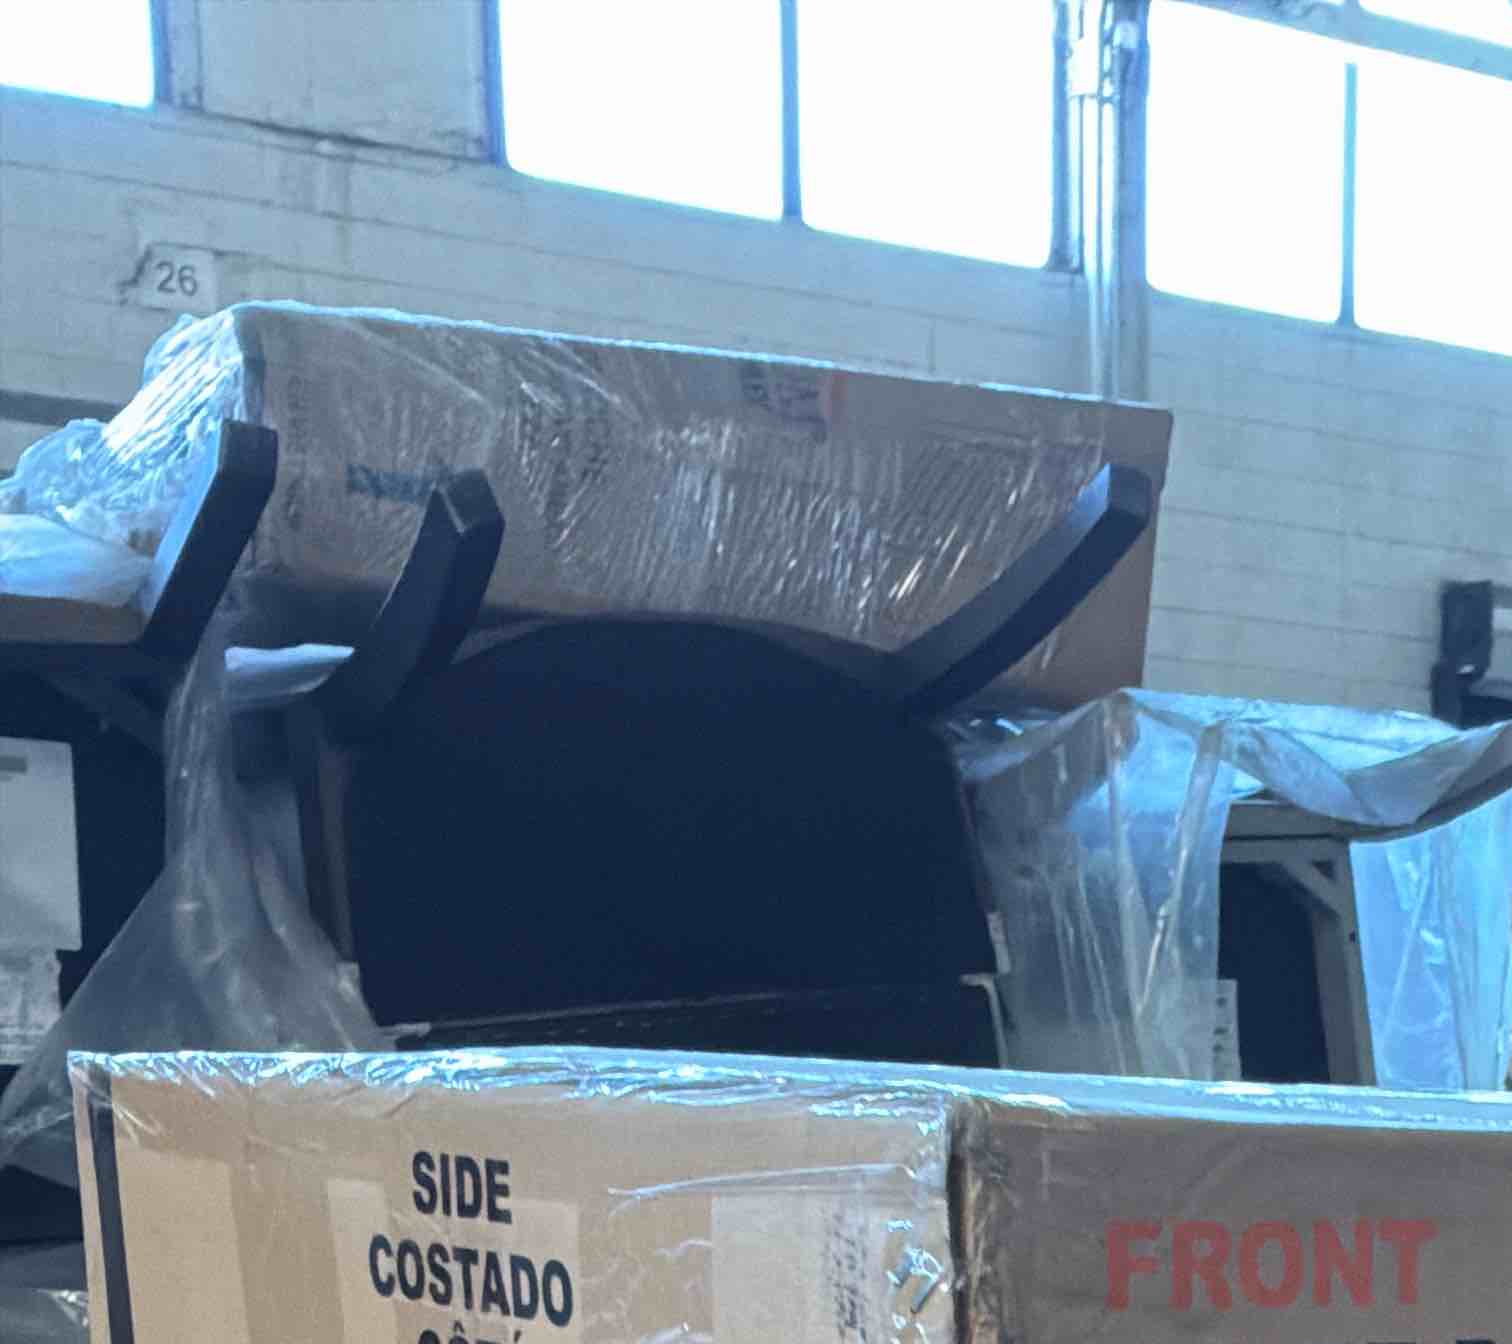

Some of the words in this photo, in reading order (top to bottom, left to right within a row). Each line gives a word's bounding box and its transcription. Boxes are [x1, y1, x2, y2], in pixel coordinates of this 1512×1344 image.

[156, 260, 198, 297] 26
[411, 1150, 513, 1224] SIDE
[369, 1235, 575, 1328] COSTADO
[1104, 1217, 1437, 1312] FRONT
